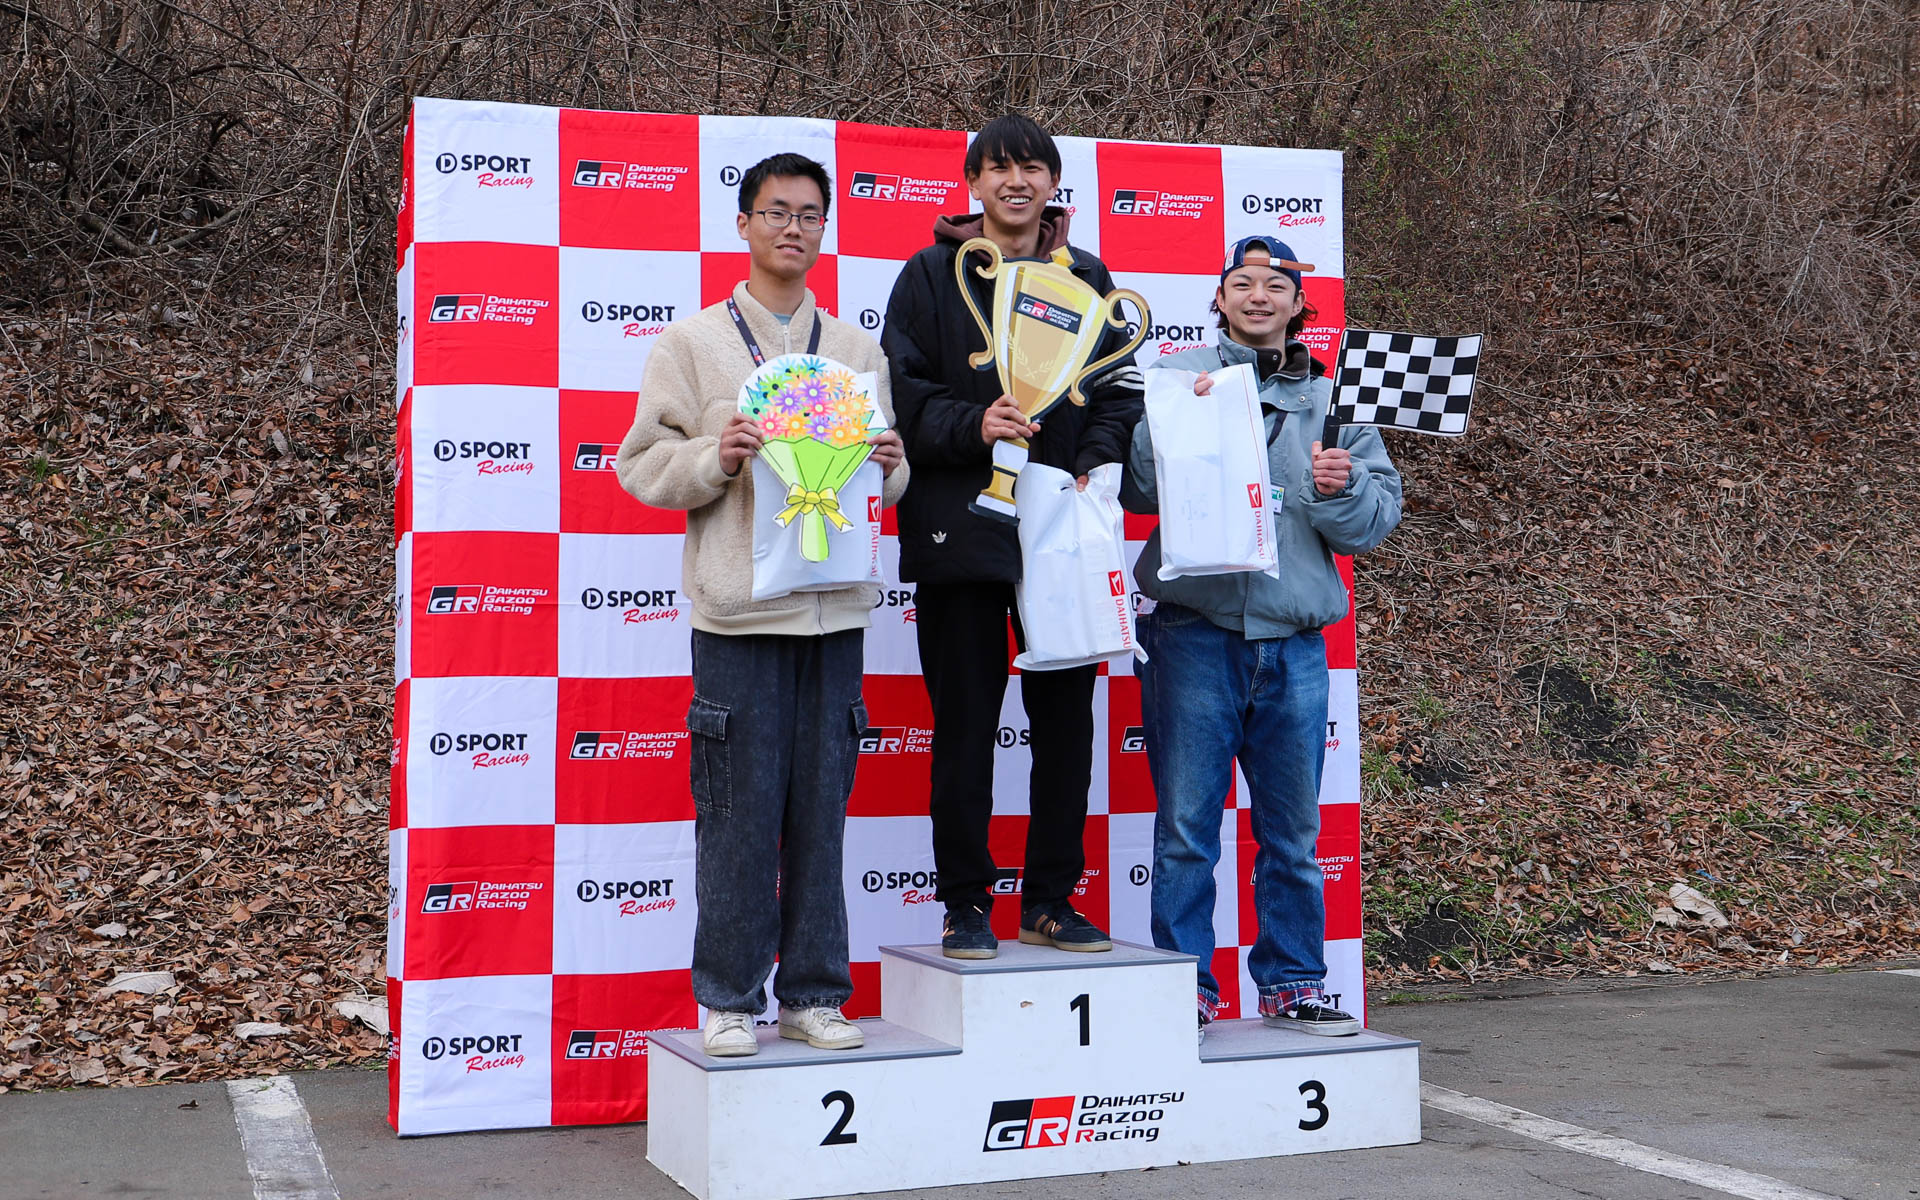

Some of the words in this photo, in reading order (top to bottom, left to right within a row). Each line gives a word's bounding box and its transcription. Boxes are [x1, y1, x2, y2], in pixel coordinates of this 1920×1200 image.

[461, 155, 531, 174] SPORT
[628, 164, 688, 173] DAIHATSU
[478, 173, 534, 188] Racing
[576, 171, 620, 186] GR
[627, 172, 676, 181] GAZOO
[902, 177, 958, 188] DAIHATSU
[625, 181, 673, 192] Racing
[853, 182, 895, 198] GR
[900, 186, 947, 195] GAZOO
[899, 193, 945, 205] Racing
[1160, 193, 1214, 202] DAIHATSU
[1114, 200, 1154, 214] GR
[1159, 201, 1203, 209] GAZOO
[1264, 198, 1322, 213] SPORT
[1158, 209, 1201, 219] Racing
[1278, 214, 1326, 228] Racing
[488, 296, 549, 307] DAIHATSU
[433, 306, 479, 320] GR
[485, 305, 537, 314] GAZOO
[607, 304, 675, 321] SPORT
[484, 313, 533, 325] Racing
[623, 323, 664, 338] Raci
[460, 442, 530, 459] SPORT
[477, 460, 534, 476] Racing
[486, 587, 548, 596] DAIHATSU
[607, 590, 676, 607] SPORT
[430, 597, 477, 611] GR
[484, 596, 535, 604] GAZOO
[482, 604, 532, 615] Racing
[623, 608, 679, 625] Racing
[1116, 599, 1132, 648] DAIHATSU
[456, 734, 527, 751] SPORT
[628, 732, 688, 740] DAIHATSU
[574, 743, 620, 757] GR
[626, 740, 676, 749] GAZOO
[859, 738, 900, 752] GR
[624, 748, 674, 759] Racing
[472, 752, 530, 770] Racing
[480, 882, 543, 891] DAIHATSU
[603, 879, 673, 900] SPORT
[425, 894, 471, 911] GR
[478, 891, 530, 900] GAZOO
[476, 899, 527, 910] Racing
[619, 898, 676, 917] Racing
[1069, 994, 1090, 1046] 1
[450, 1034, 522, 1055] SPORT
[569, 1042, 616, 1057] GR
[620, 1048, 648, 1057] Rac
[466, 1054, 525, 1074] Racing
[1081, 1092, 1184, 1109] DAIHATSU
[1298, 1080, 1329, 1131] 3
[820, 1090, 857, 1146] 2
[1078, 1109, 1164, 1126] GAZOO
[987, 1116, 1069, 1149] GR
[1075, 1126, 1159, 1143] Racing
